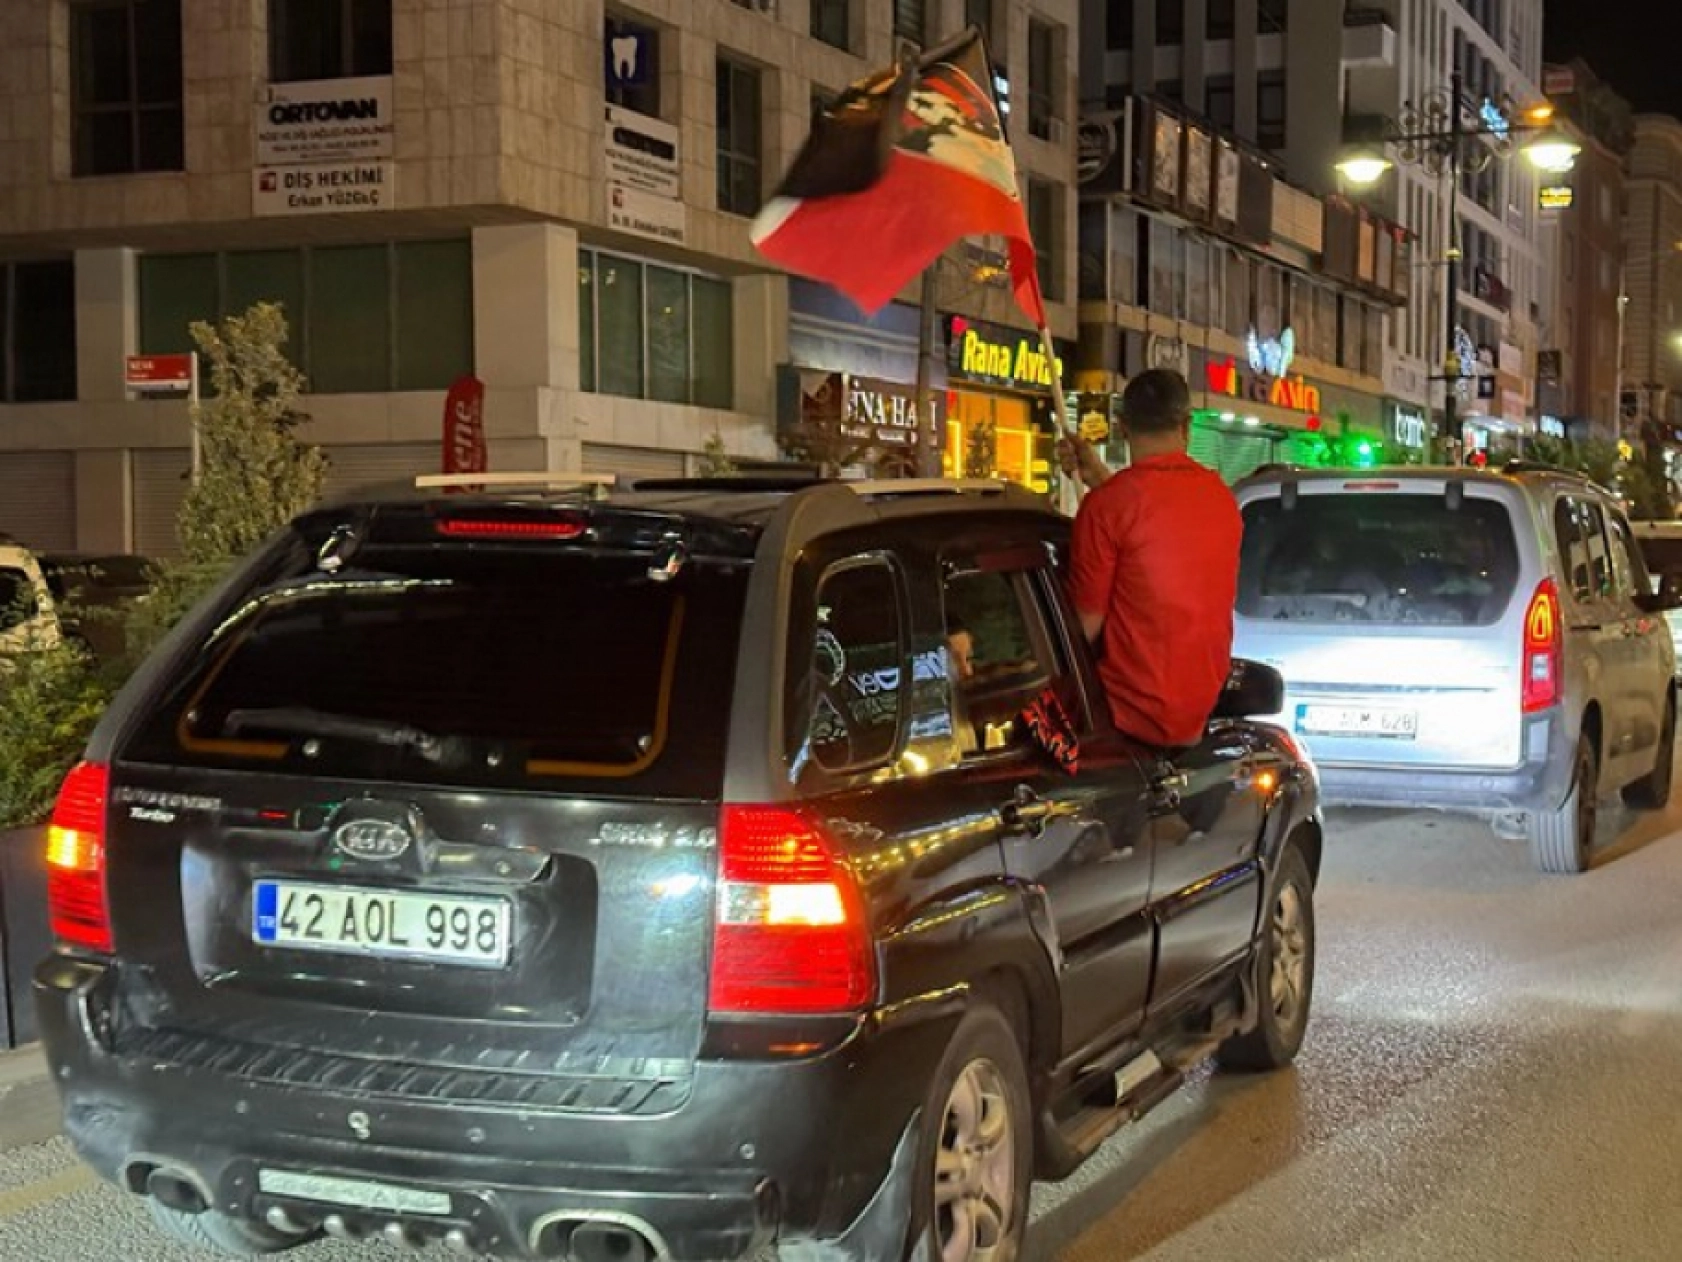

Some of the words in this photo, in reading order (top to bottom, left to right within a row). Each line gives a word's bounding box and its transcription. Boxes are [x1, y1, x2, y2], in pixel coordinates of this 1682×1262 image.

[269, 97, 378, 125] ORTOVAN
[962, 329, 1011, 378] Rana
[1013, 339, 1063, 386] Avi
[281, 892, 326, 938] 42
[339, 896, 409, 945] AOL
[426, 903, 497, 952] 998
